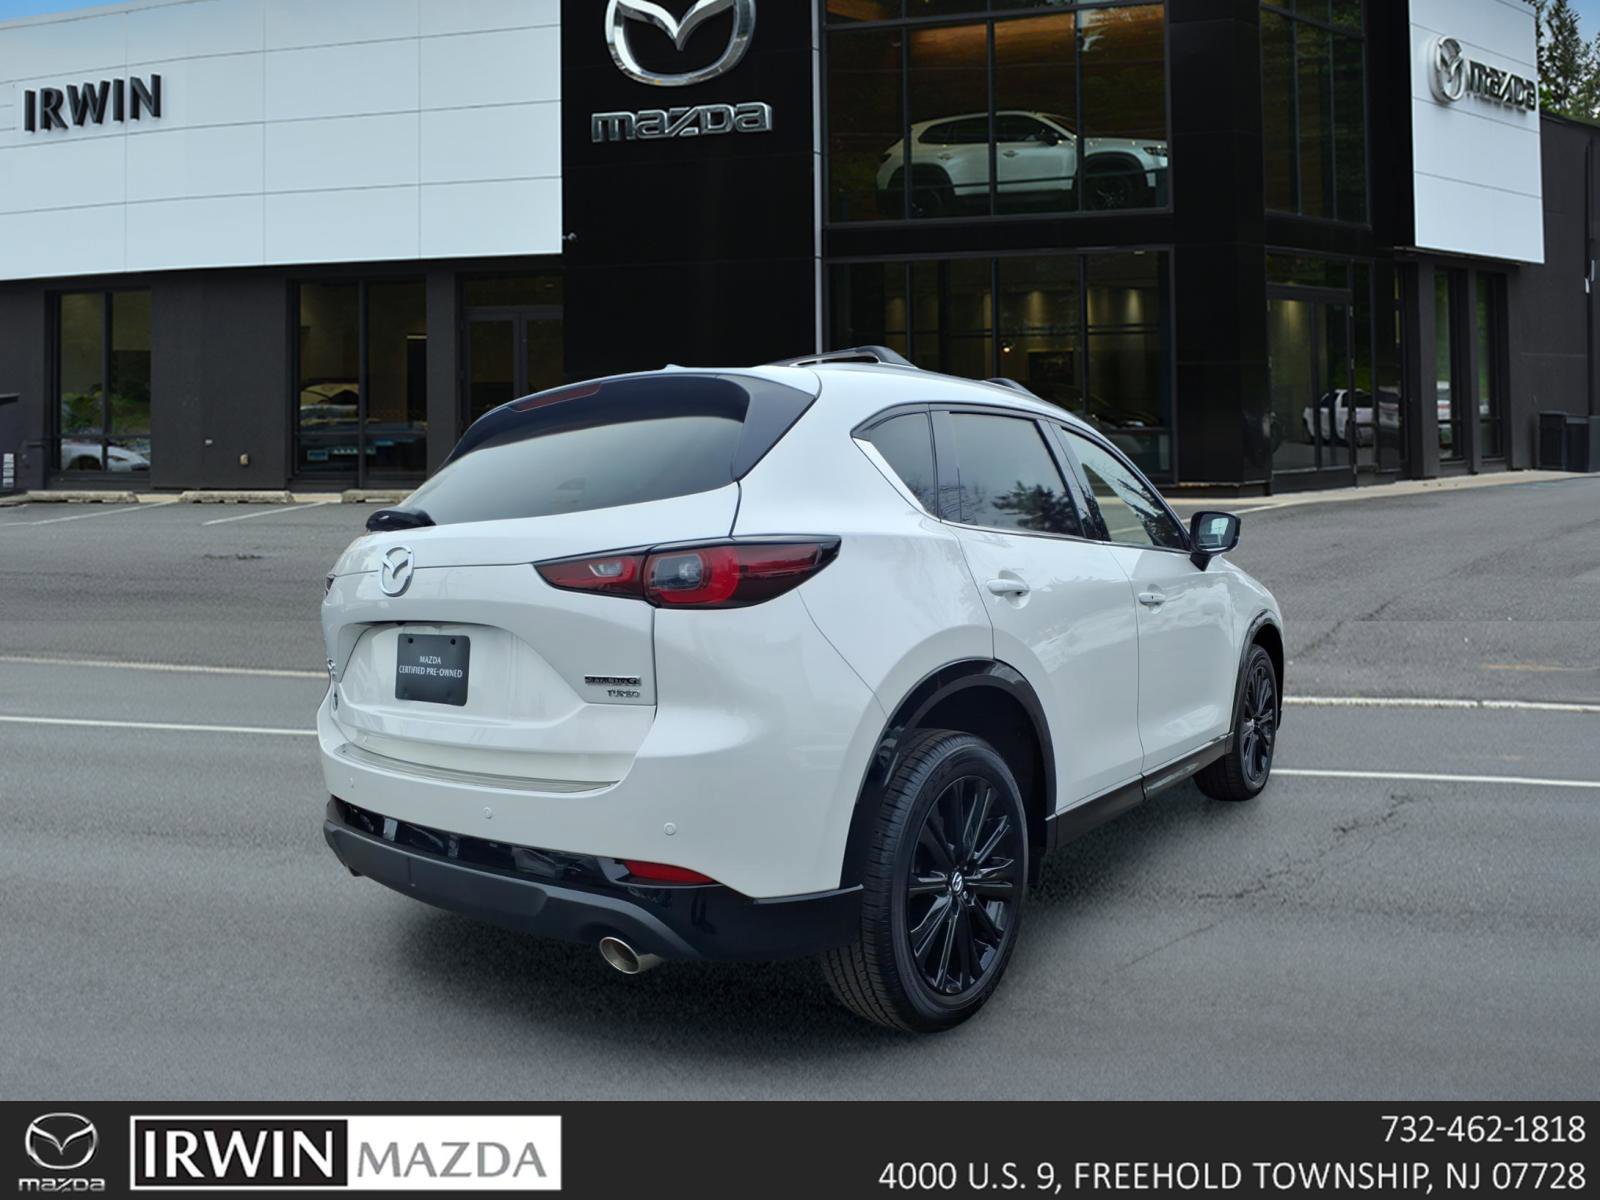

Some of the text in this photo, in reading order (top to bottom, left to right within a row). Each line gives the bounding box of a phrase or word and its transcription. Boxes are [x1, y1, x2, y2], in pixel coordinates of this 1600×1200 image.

[25, 74, 161, 132] IRWIN
[419, 655, 442, 664] MAZDA
[398, 665, 463, 678] CERTIFIED PRE-OWNED
